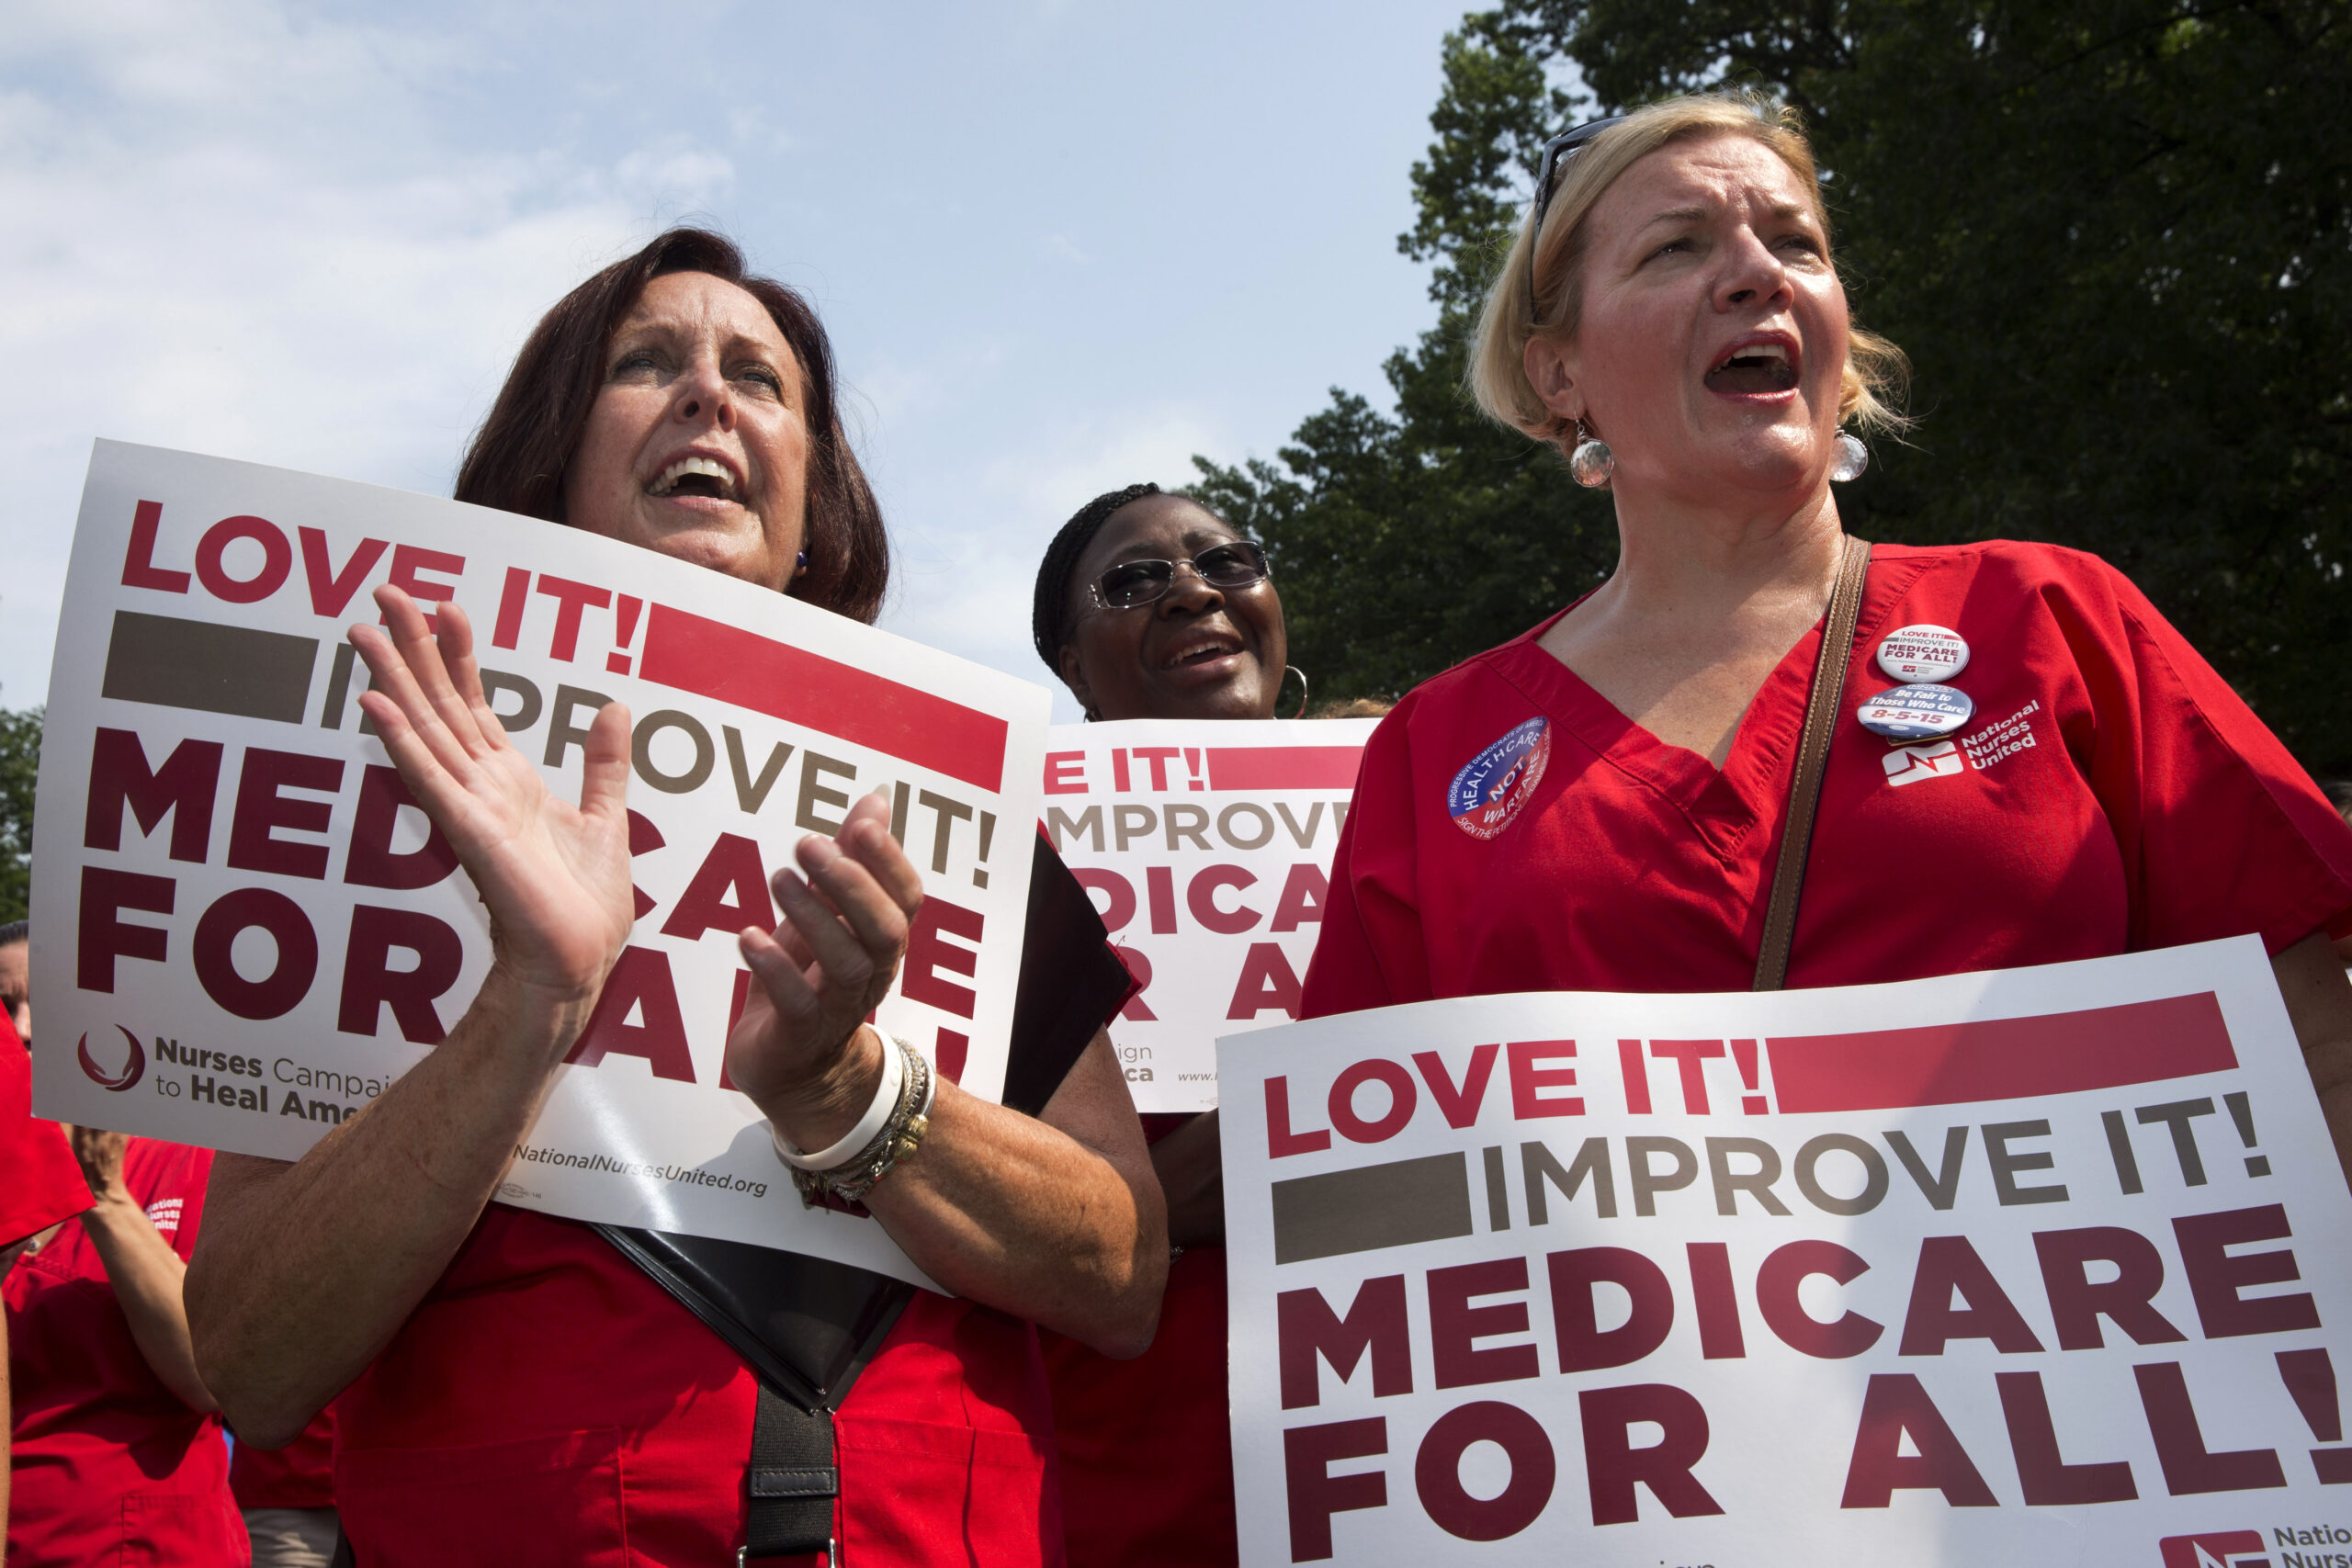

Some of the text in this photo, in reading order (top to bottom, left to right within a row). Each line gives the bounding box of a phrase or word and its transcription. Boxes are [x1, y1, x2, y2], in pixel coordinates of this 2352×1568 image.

[121, 499, 643, 676] LOVE IT!
[1884, 650, 1958, 663] FOR ALL!
[1886, 644, 1960, 657] MEDICARE
[1899, 637, 1945, 647] IMPROVE
[1902, 630, 1929, 638] LOVE
[1870, 696, 1966, 714] Those Who Care
[1871, 709, 1945, 724] 8-5-15
[1895, 689, 1952, 702] Be Fair to
[1961, 699, 2041, 748] National
[1966, 720, 2030, 760] Nurses
[321, 641, 996, 889] IPROVE IT!
[1112, 747, 1204, 792] IT!
[1450, 764, 1474, 807] PROGRESSIVE
[1472, 730, 1515, 765] DEMOCRATS
[1971, 733, 2037, 770] United
[1483, 750, 1541, 823] WARFARE
[1489, 756, 1524, 802] NOT
[1046, 802, 1350, 852] MPROV
[1458, 817, 1476, 834] SIGN
[1476, 828, 1493, 838] THE
[1067, 863, 1330, 935] DICA
[77, 866, 462, 1045] FOR
[155, 1036, 390, 1099] Nurses Campai
[155, 1075, 181, 1098] to
[191, 1074, 268, 1113] Heal
[1263, 1038, 1770, 1159] LOVE IT!
[1482, 1090, 2273, 1233] IMPROVE IT!
[1277, 1202, 2323, 1410] MEDICARE
[1283, 1347, 2352, 1563] FOR ALL!
[2273, 1524, 2352, 1547] Natio
